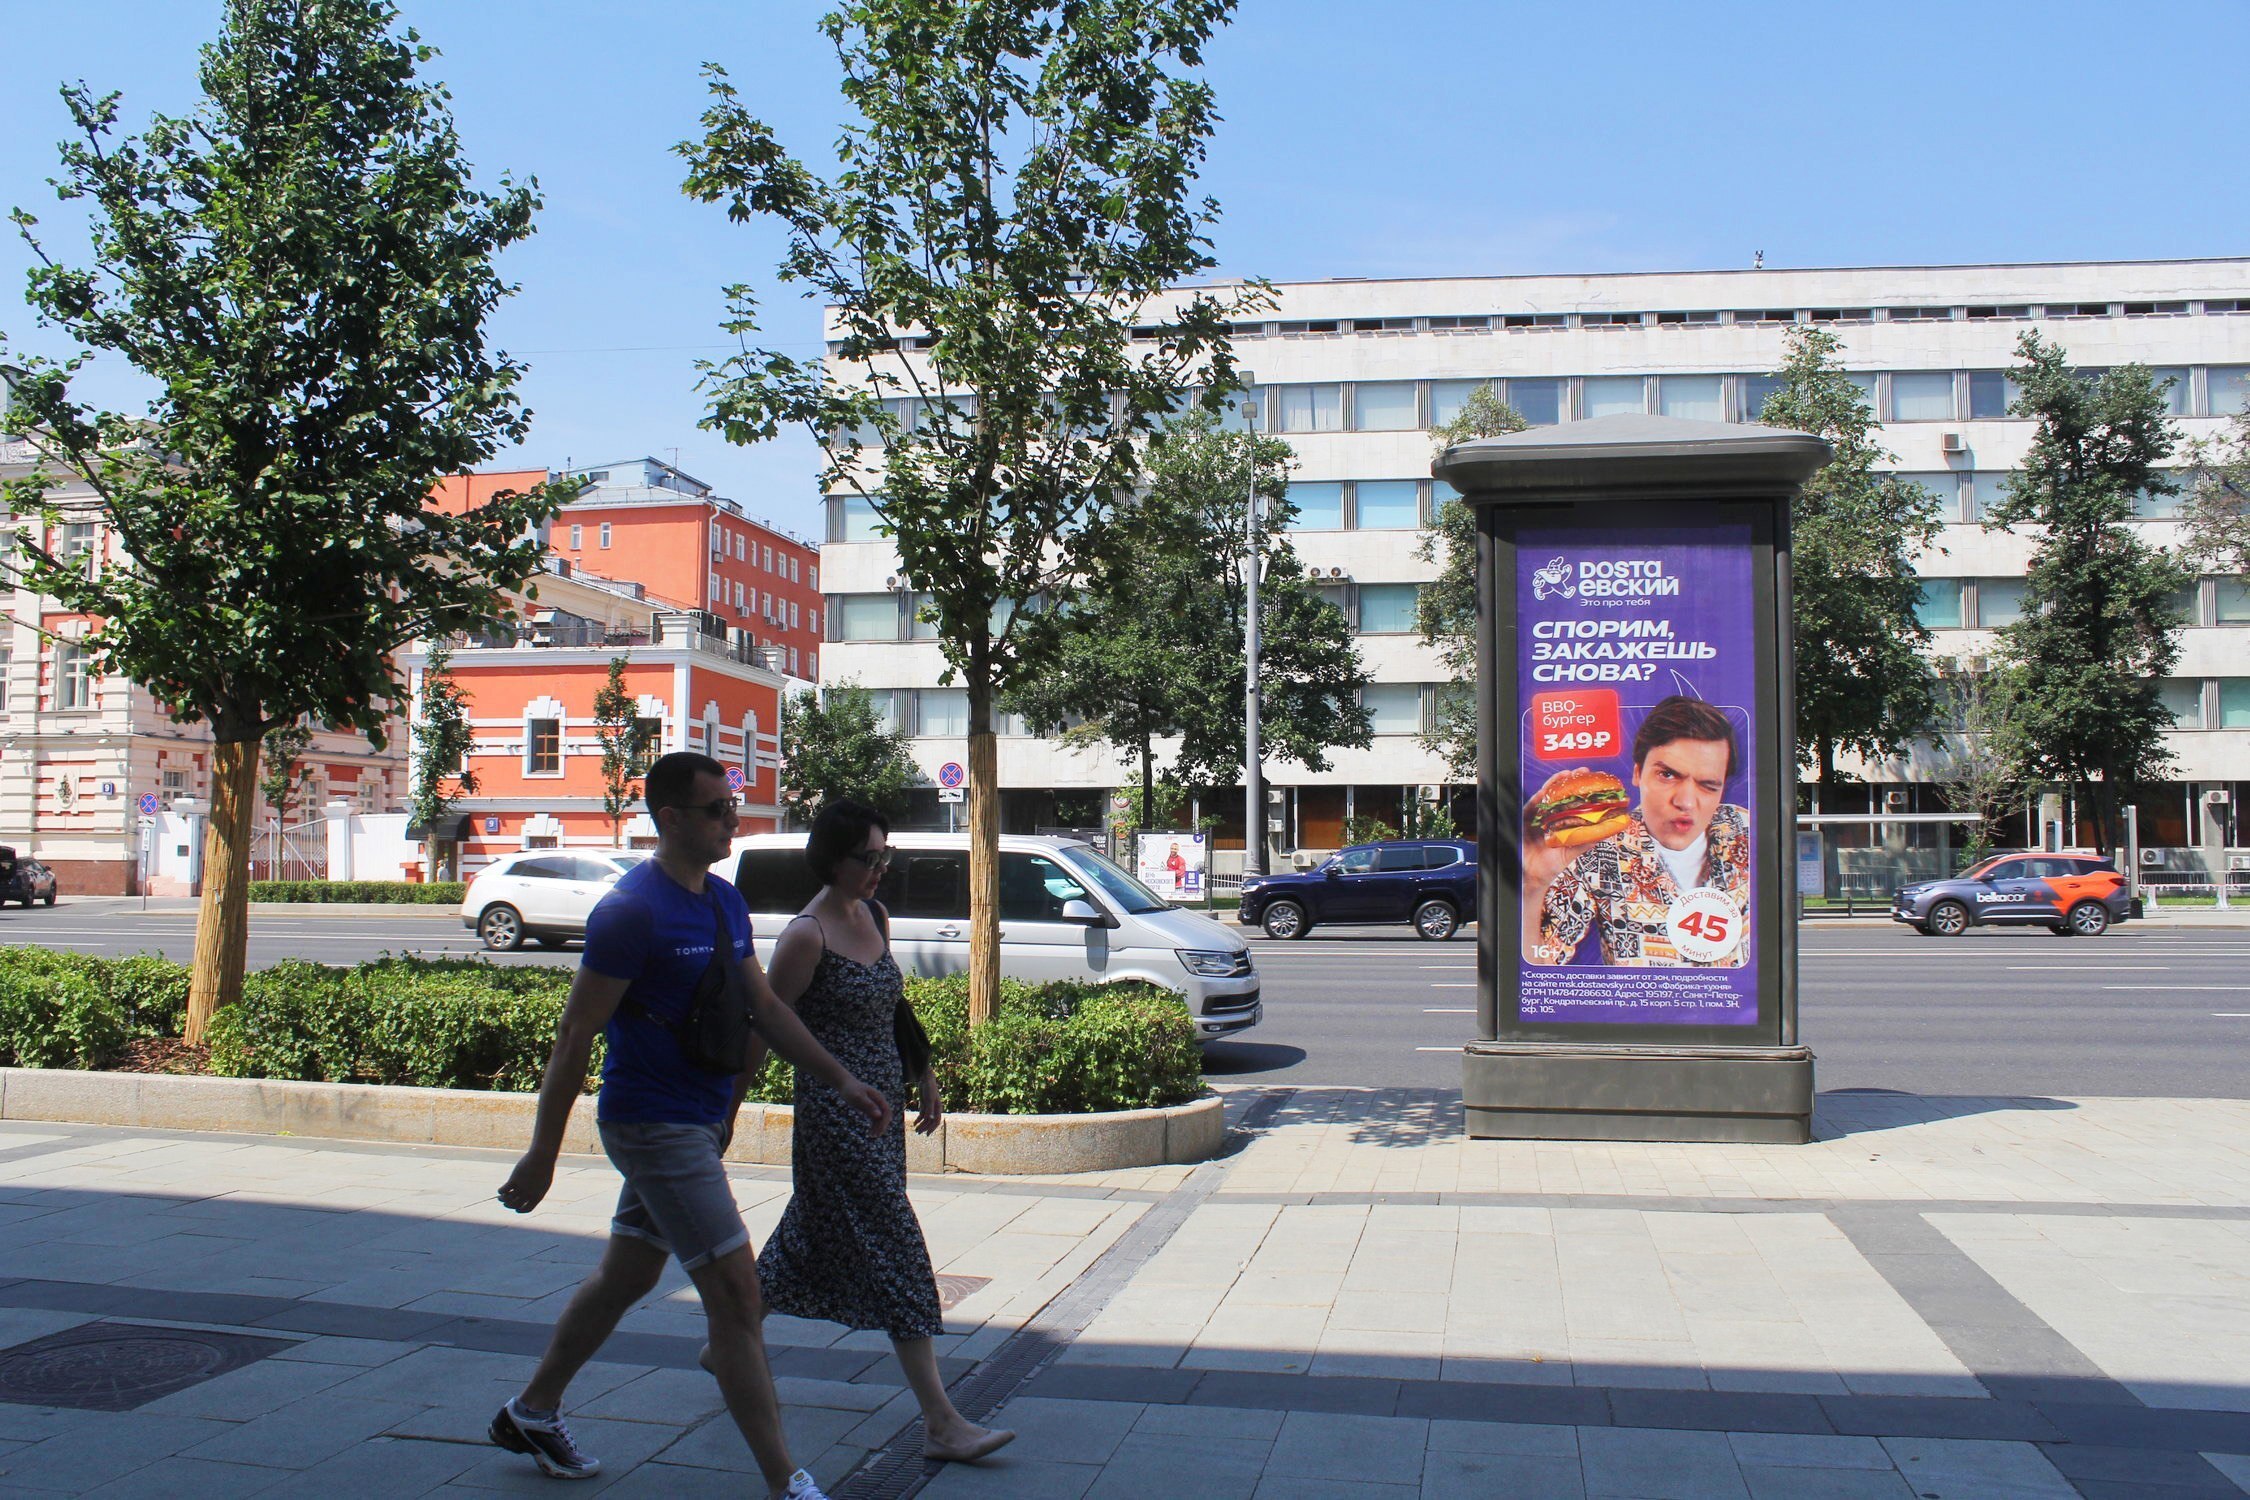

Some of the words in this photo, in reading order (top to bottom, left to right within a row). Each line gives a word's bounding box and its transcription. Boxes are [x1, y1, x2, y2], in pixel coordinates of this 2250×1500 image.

[1580, 598, 1600, 607] Это
[1602, 599, 1624, 608] про
[1625, 598, 1651, 607] тебя
[1532, 620, 1675, 640] СПОРИМ,
[1531, 641, 1717, 661] ЗАКАЖЕШЬ
[1532, 663, 1657, 682] СНОВА?
[1542, 700, 1583, 714] BBQ-
[1542, 714, 1596, 728] бургер
[104, 783, 110, 792] 9
[488, 820, 495, 828] 9
[1679, 891, 1730, 907] Доставим
[1729, 907, 1739, 918] за
[1677, 911, 1728, 942] 45
[1531, 944, 1559, 959] 16+
[1681, 944, 1713, 960] минут
[1559, 980, 1634, 990] msk.dostaevsky.ru
[1566, 973, 1605, 981] доставки
[1606, 973, 1640, 981] зависит
[1671, 974, 1728, 983] подробности
[1521, 988, 1546, 996] ОГРН
[1521, 1006, 1538, 1014] оф.
[1543, 997, 1614, 1006] Кондратьевский
[1640, 999, 1649, 1007] 15
[1649, 1000, 1672, 1008] корп.
[1673, 999, 1680, 1007] 5
[1681, 1001, 1697, 1009] стр.
